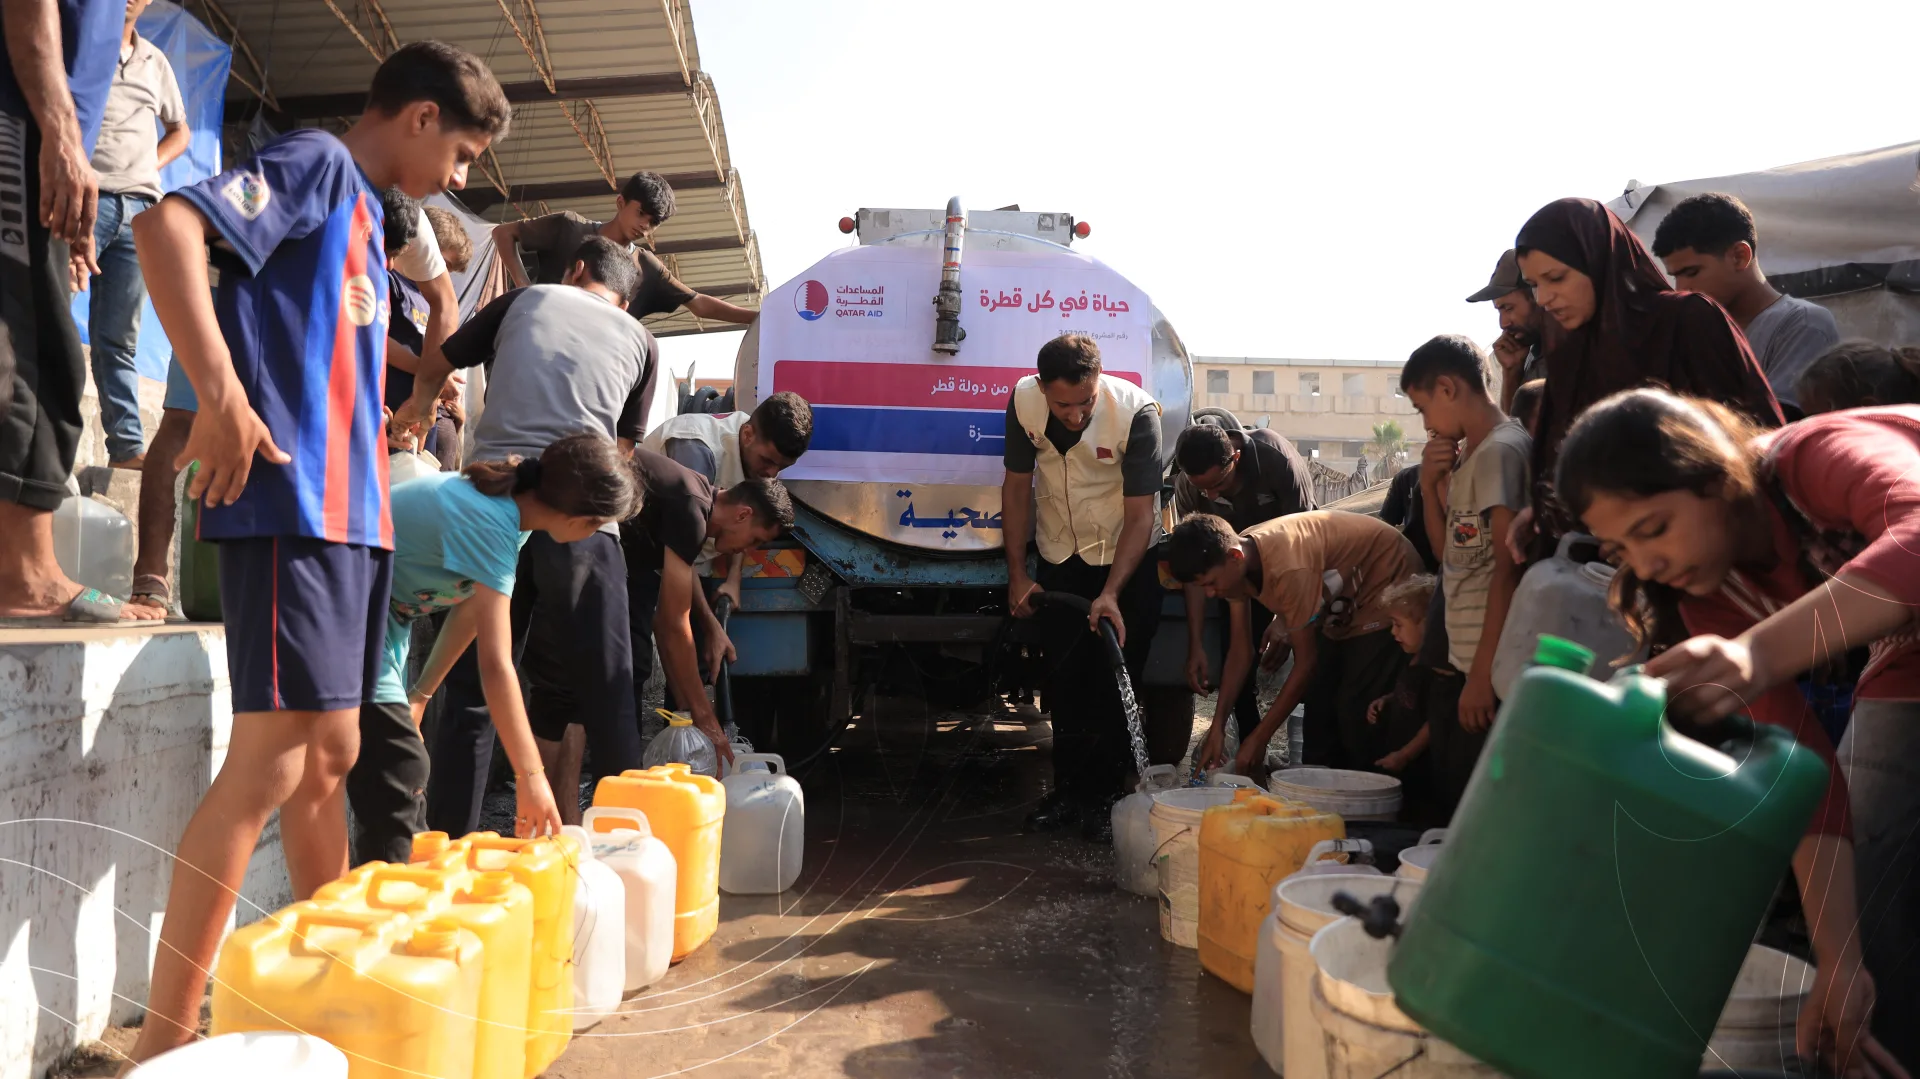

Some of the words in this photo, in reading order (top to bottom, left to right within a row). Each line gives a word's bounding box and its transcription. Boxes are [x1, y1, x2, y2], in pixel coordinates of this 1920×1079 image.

[836, 285, 884, 295] المساعدات
[836, 296, 884, 306] القطرية
[980, 287, 1022, 312] قطرة
[1027, 289, 1055, 313] كل
[1059, 290, 1088, 317] في
[1092, 293, 1130, 317] حياة
[836, 309, 866, 318] QATAR
[867, 310, 883, 318] AID
[931, 377, 955, 395] قطر
[959, 379, 987, 395] دولة
[990, 383, 1009, 396] من
